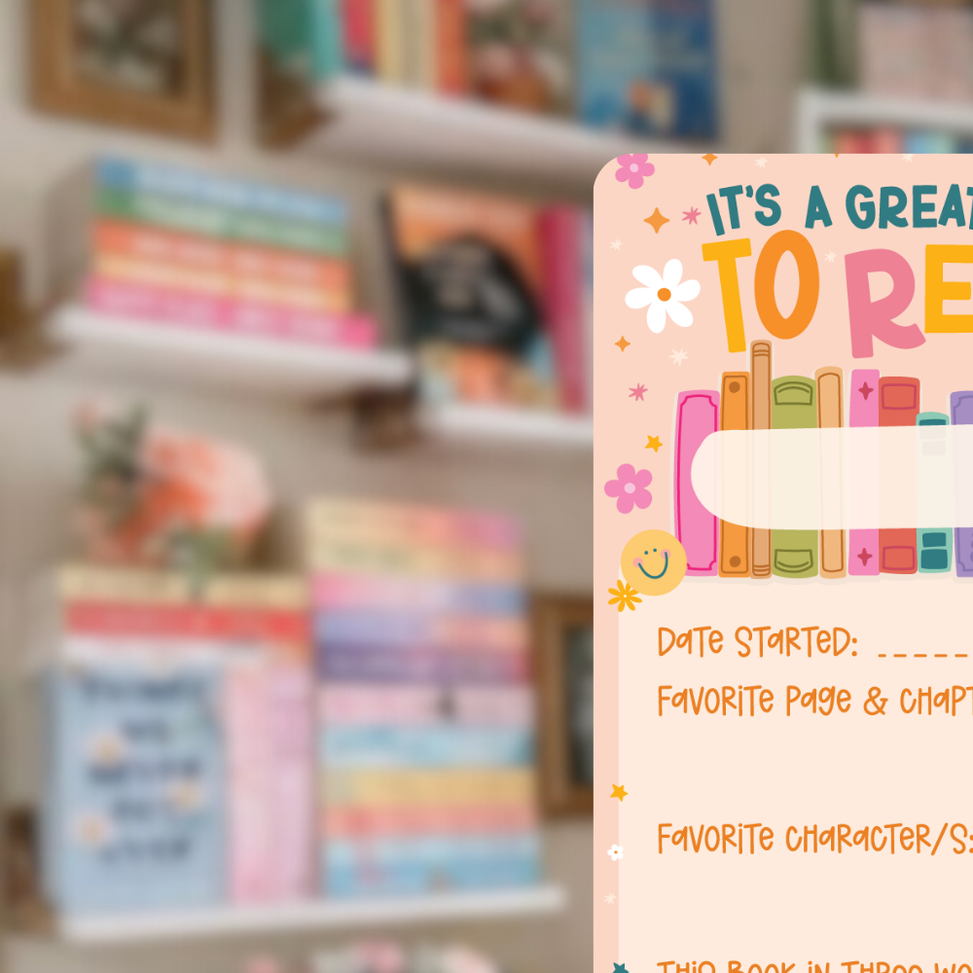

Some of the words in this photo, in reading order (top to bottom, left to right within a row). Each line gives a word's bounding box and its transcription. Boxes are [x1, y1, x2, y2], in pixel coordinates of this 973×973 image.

[706, 183, 782, 236] IT'S
[805, 185, 833, 229] A
[701, 229, 820, 353] TO
[863, 686, 889, 716] &
